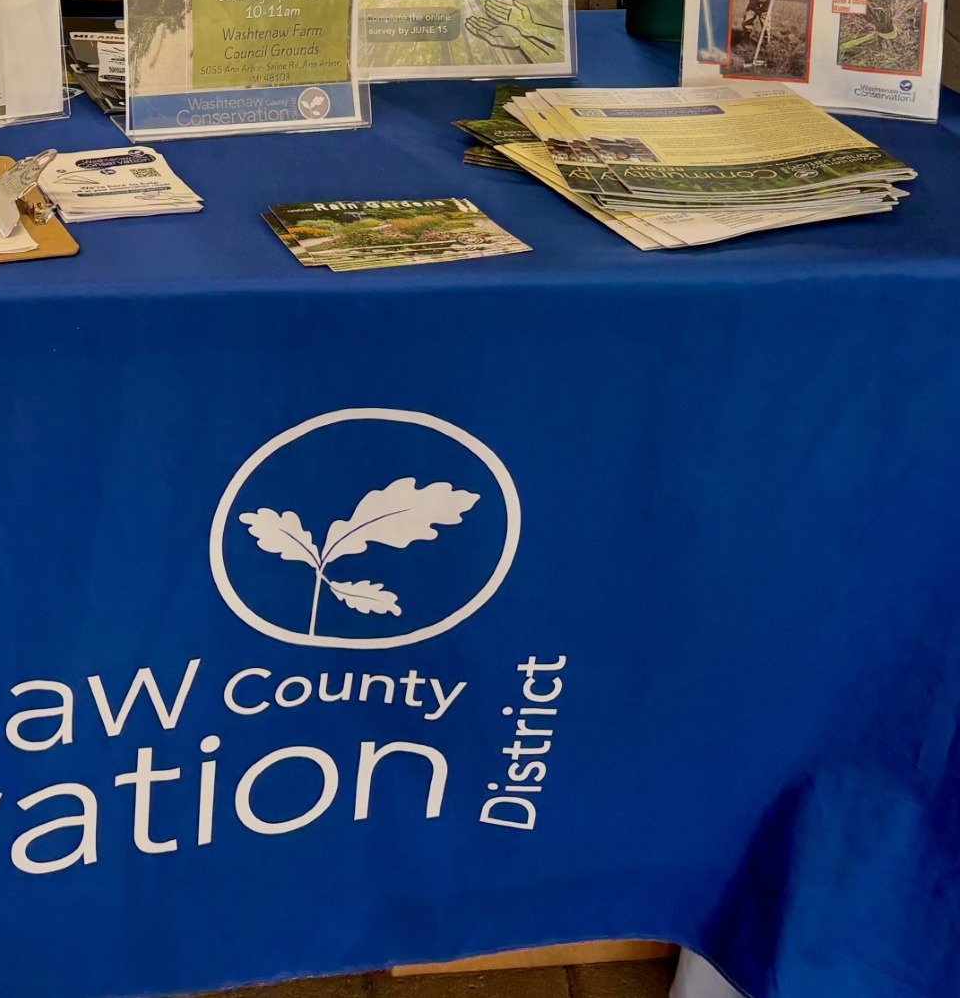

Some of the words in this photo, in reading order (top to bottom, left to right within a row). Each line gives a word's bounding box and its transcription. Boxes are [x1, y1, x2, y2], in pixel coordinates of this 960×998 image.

[244, 5, 301, 19] 10-11am
[222, 27, 289, 41] Washtenaw
[292, 24, 322, 38] Farm
[369, 28, 395, 36] survey
[399, 27, 408, 36] by
[224, 44, 267, 61] Council
[270, 44, 319, 57] Grounds
[854, 88, 912, 102] Conservation
[188, 96, 264, 110] Washtenaw
[176, 106, 290, 127] Conservation
[623, 168, 778, 180] Community
[313, 202, 358, 212] Rain
[364, 200, 446, 209] Gardens
[224, 668, 468, 720] County
[480, 656, 567, 830] District
